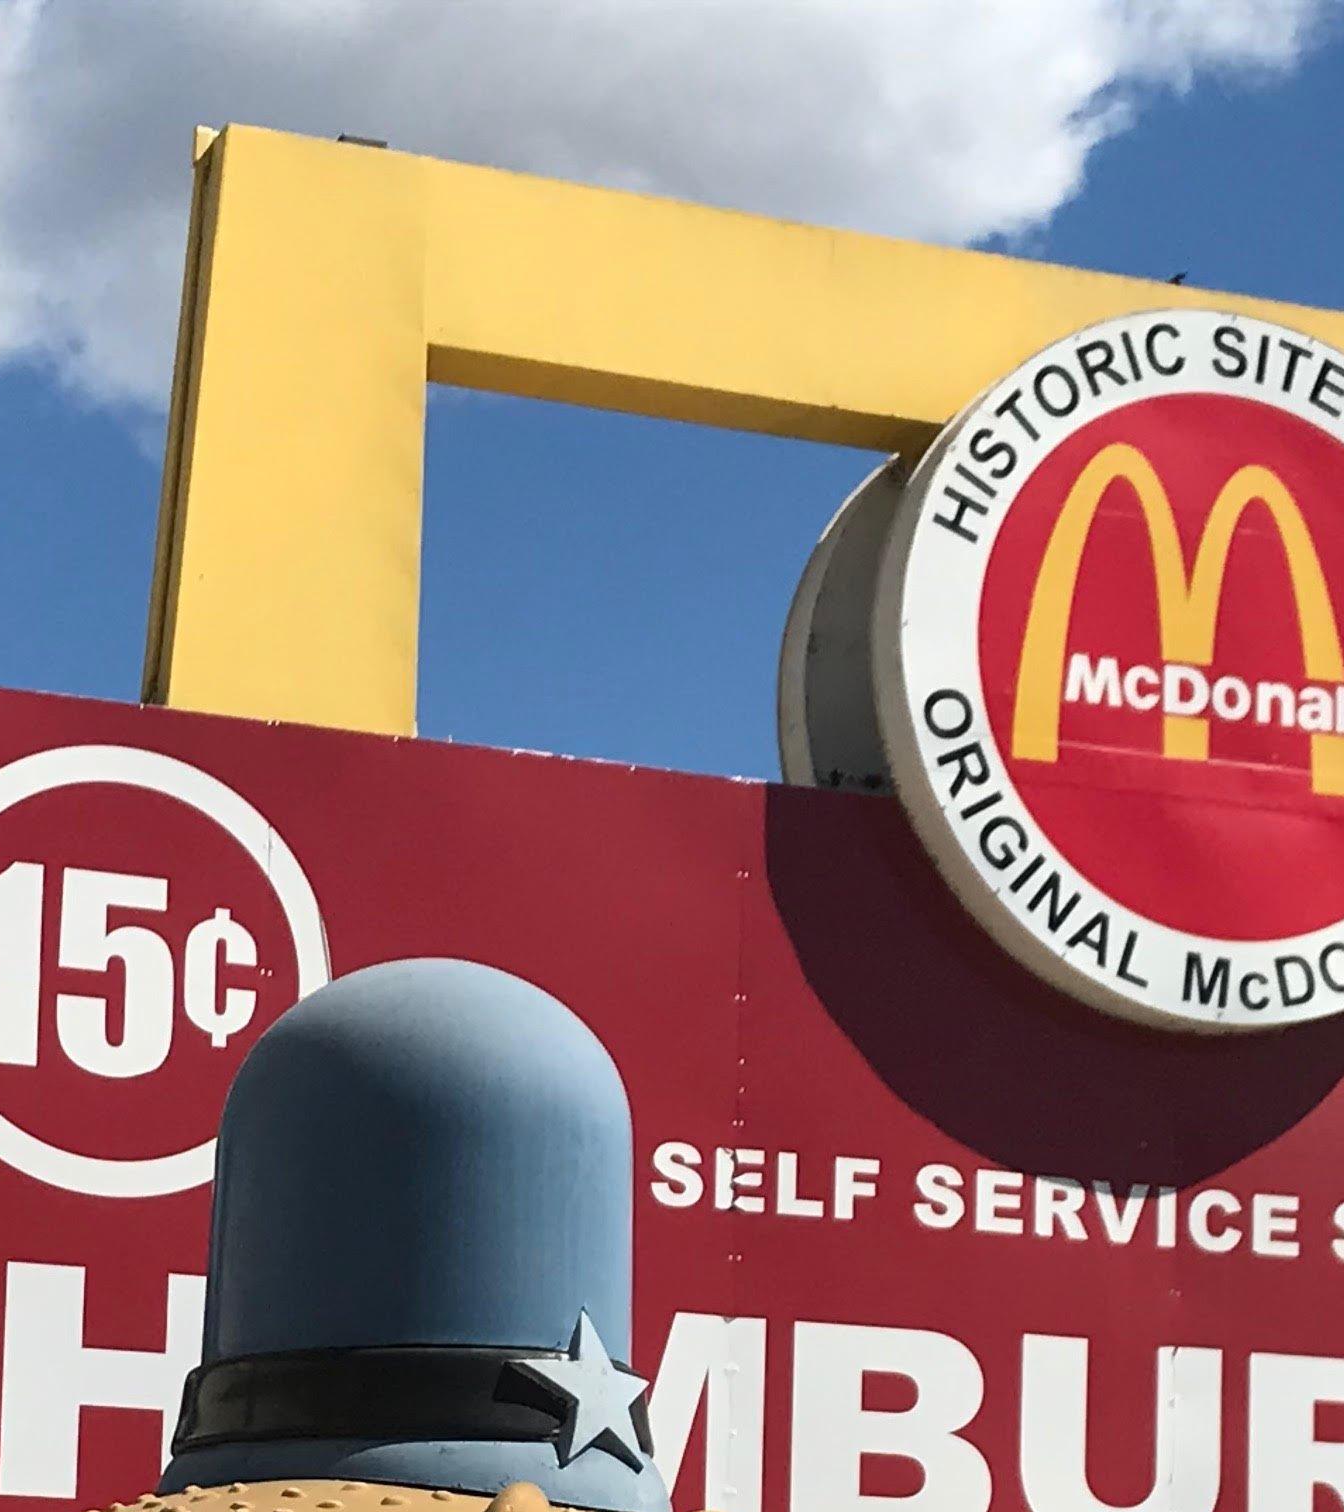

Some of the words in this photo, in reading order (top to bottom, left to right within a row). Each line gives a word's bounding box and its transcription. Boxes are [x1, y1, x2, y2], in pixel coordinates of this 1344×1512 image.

[932, 323, 1187, 545] HISTORIC
[923, 689, 1149, 988] ORIGINAL
[650, 1141, 881, 1220] SELF
[912, 1163, 1301, 1260] SERVICE
